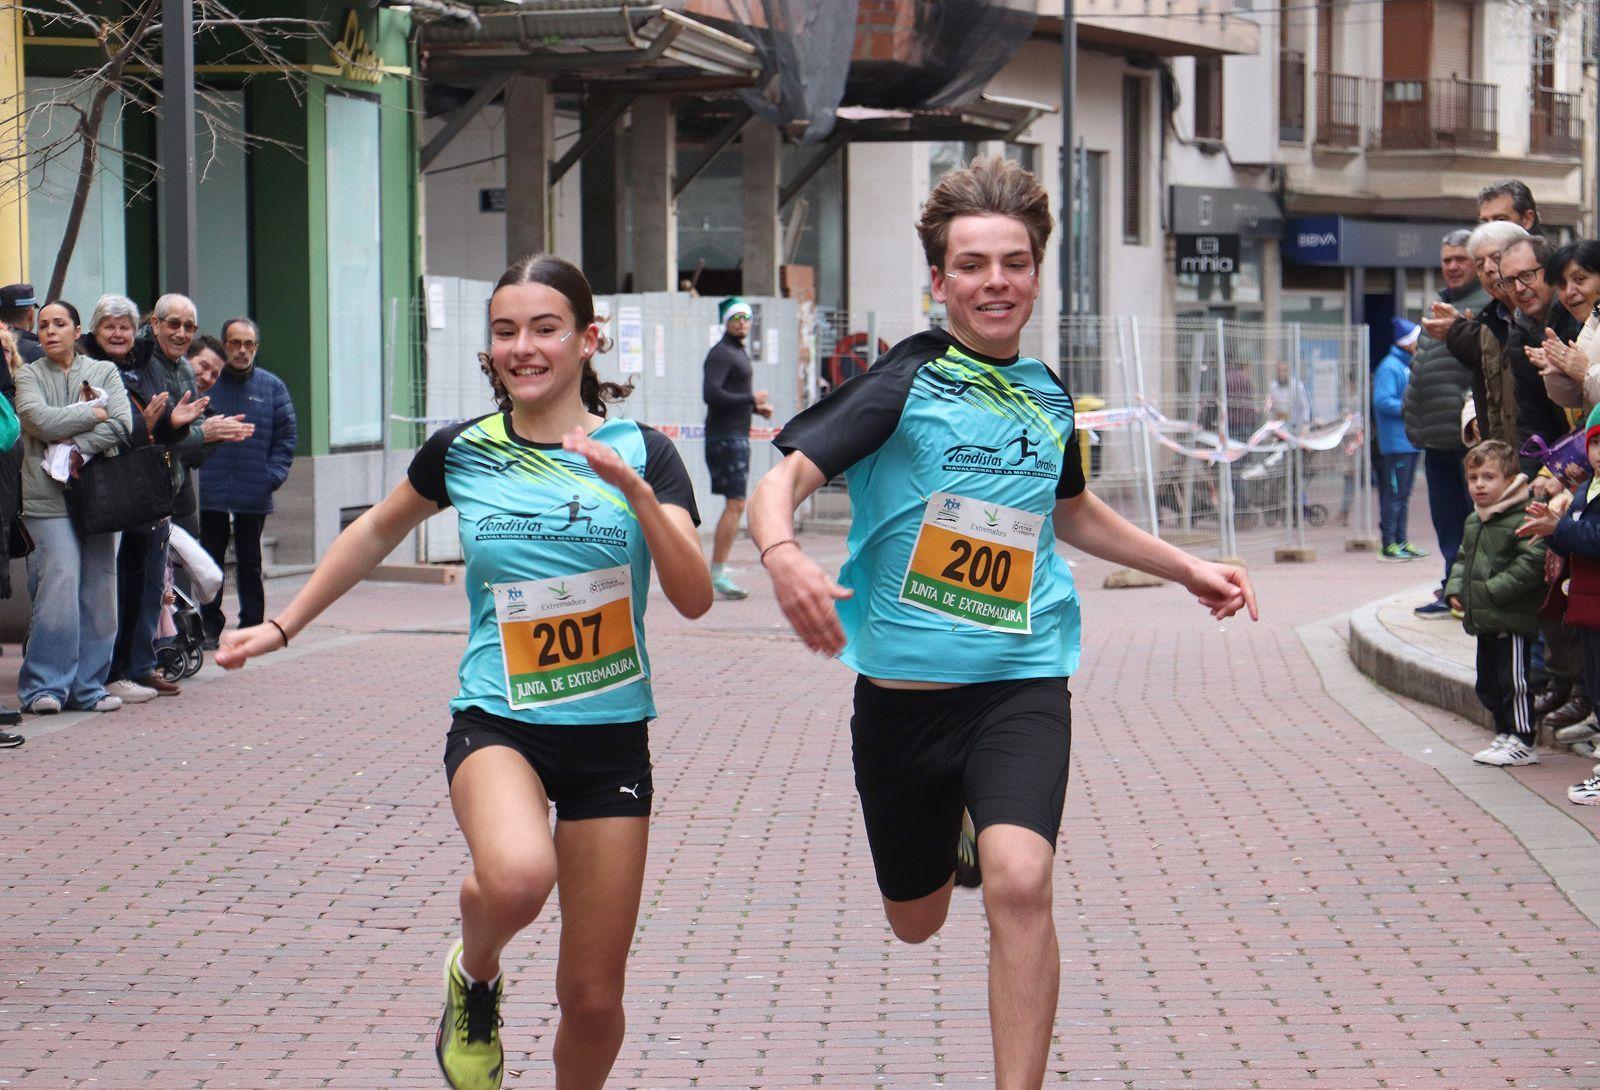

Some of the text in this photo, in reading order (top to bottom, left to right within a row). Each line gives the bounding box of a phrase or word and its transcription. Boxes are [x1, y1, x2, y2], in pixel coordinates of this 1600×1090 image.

[1297, 232, 1337, 248] BBVA
[970, 522, 1008, 538] Extremadura
[941, 539, 1012, 593] 200
[540, 598, 587, 611] Extremadura
[909, 580, 1023, 623] JUNTA DE EXTREMADURA
[533, 612, 602, 667] 207
[516, 657, 636, 700] JUNTA DE EXTREMADURA
